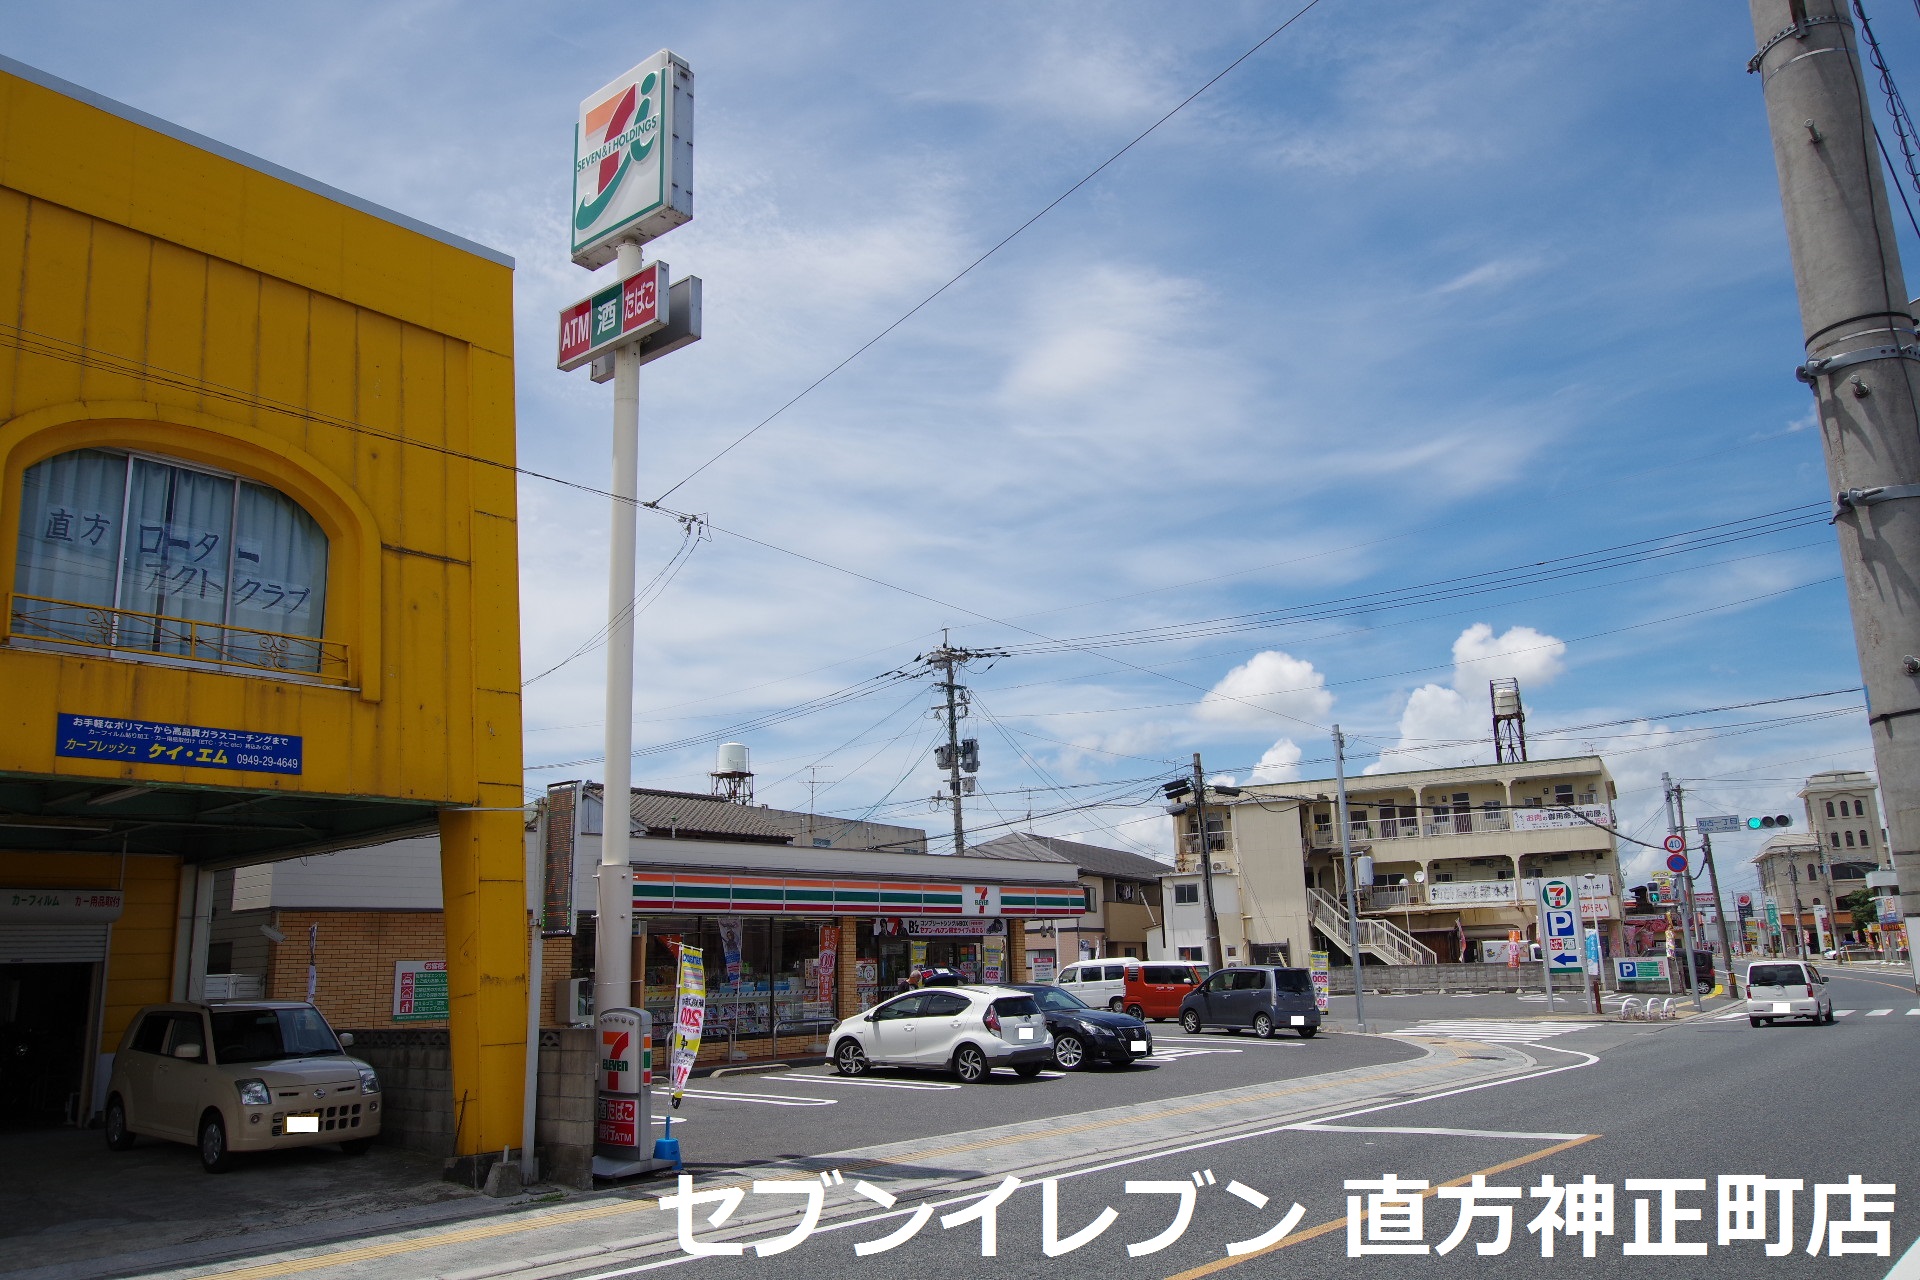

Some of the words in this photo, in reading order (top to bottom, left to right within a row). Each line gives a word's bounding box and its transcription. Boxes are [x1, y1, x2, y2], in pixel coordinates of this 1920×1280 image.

[613, 115, 658, 153] HOLDINGS
[562, 311, 590, 352] ATM
[597, 298, 617, 335] 酒
[625, 280, 655, 321] たばこ
[46, 508, 111, 546] 直方
[64, 738, 137, 755] カーフレッシュ
[148, 743, 228, 765] ケイ・エム
[236, 753, 299, 769] 0949-29-4649
[1669, 840, 1680, 849] 40
[12, 895, 60, 907] カーフィルム
[607, 1102, 634, 1121] たばこ
